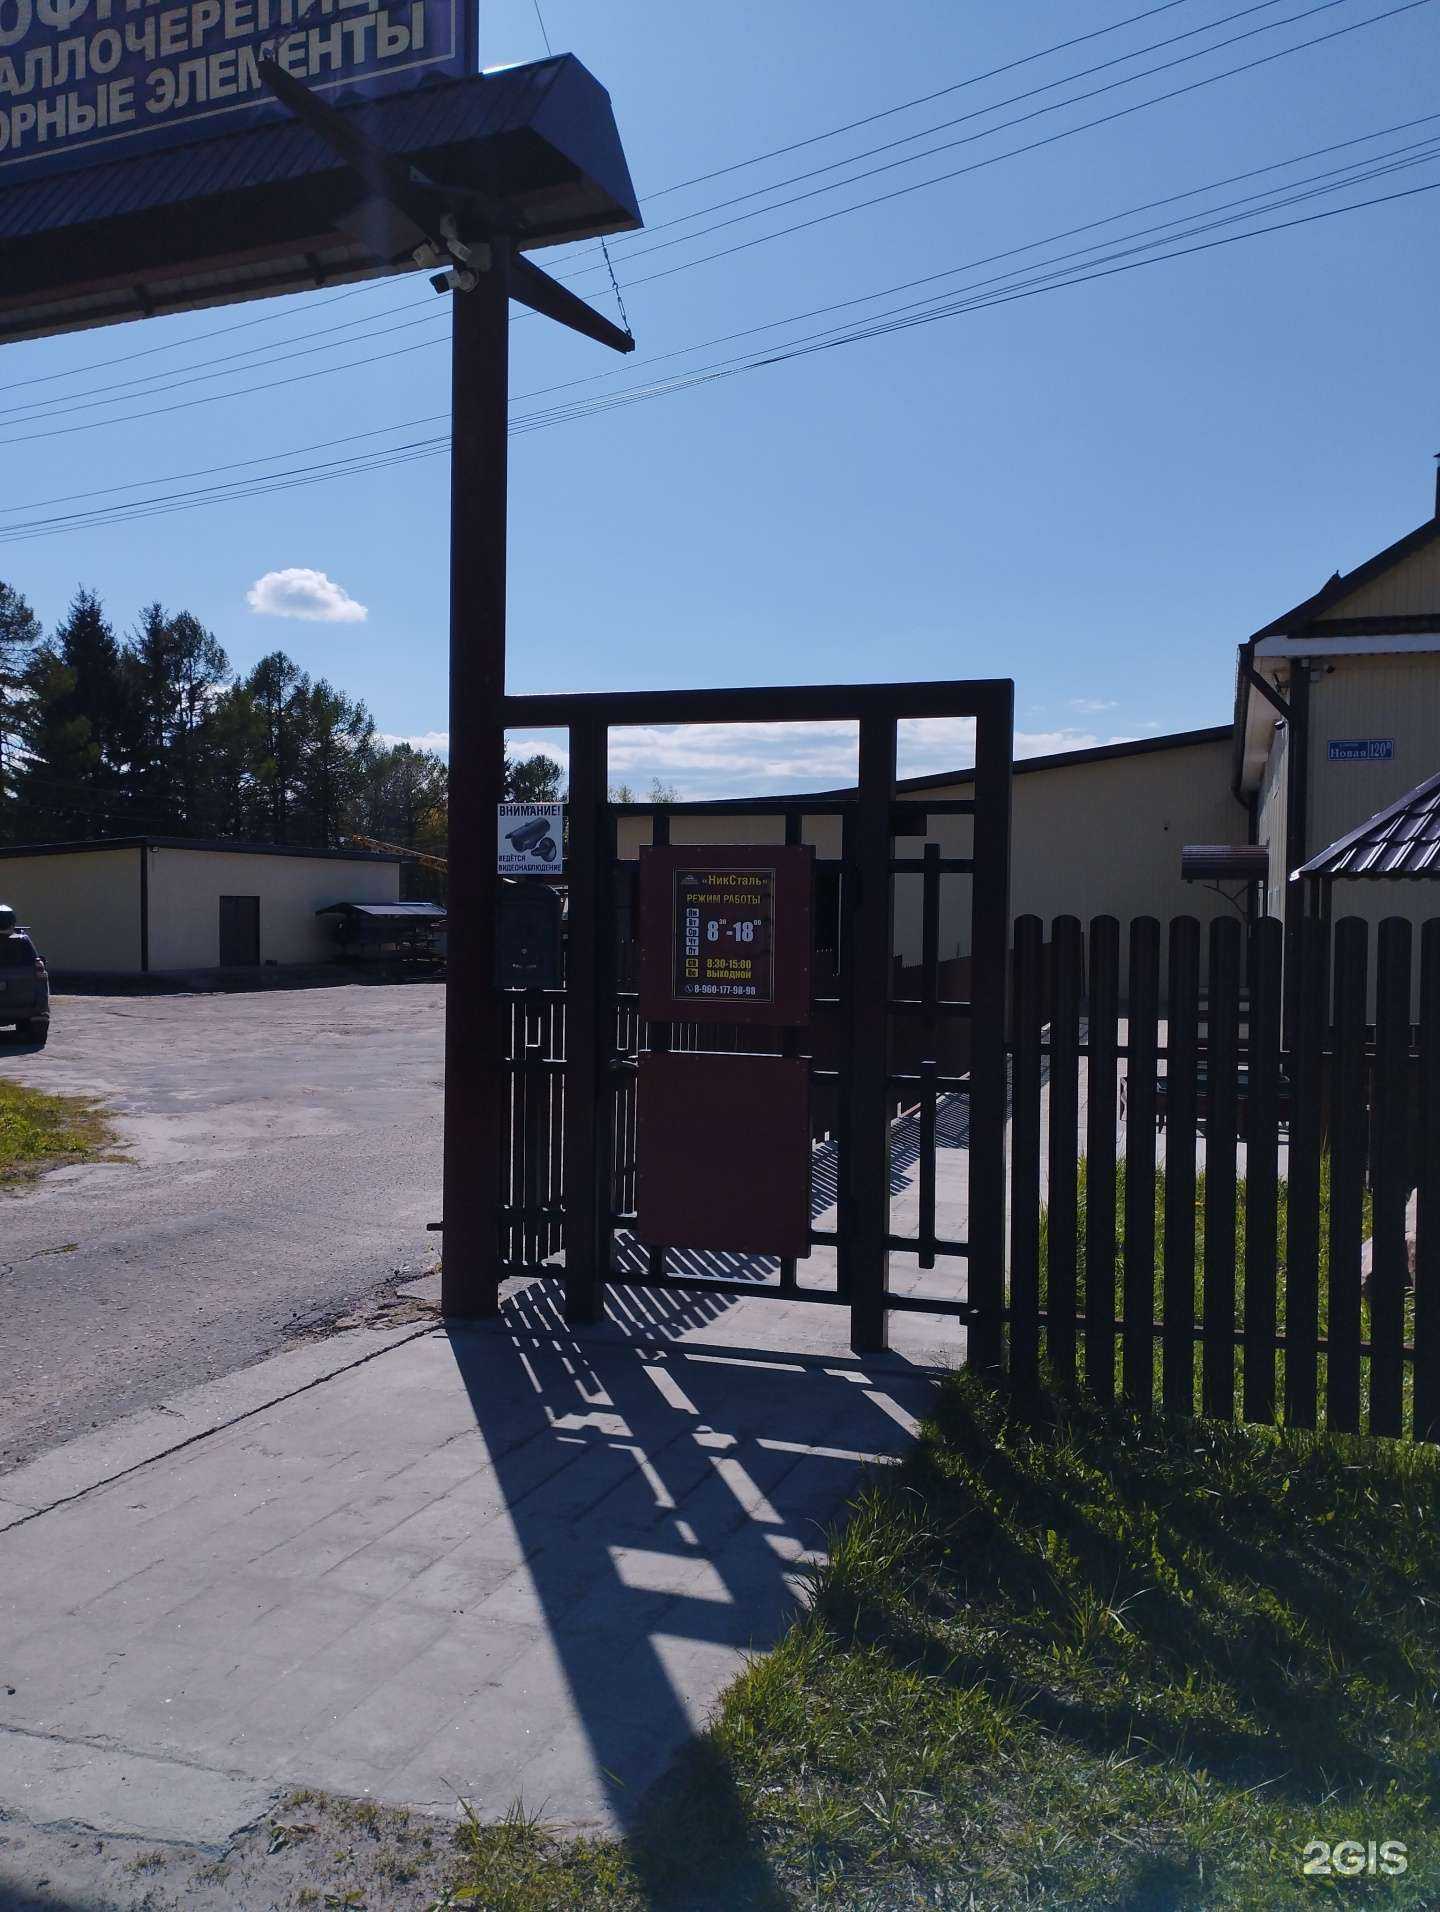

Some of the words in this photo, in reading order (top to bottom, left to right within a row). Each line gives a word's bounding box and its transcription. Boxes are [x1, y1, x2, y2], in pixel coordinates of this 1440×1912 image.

[145, 1, 425, 114] ЭЛЕМЕНТЫ
[499, 805, 561, 816] ВНИМАНИЕ!
[499, 864, 561, 872] ВИДЕОНАБЛЮДЕНИЕ
[687, 894, 720, 903] РЕЖИМ
[723, 894, 761, 904] РАБОТЫ
